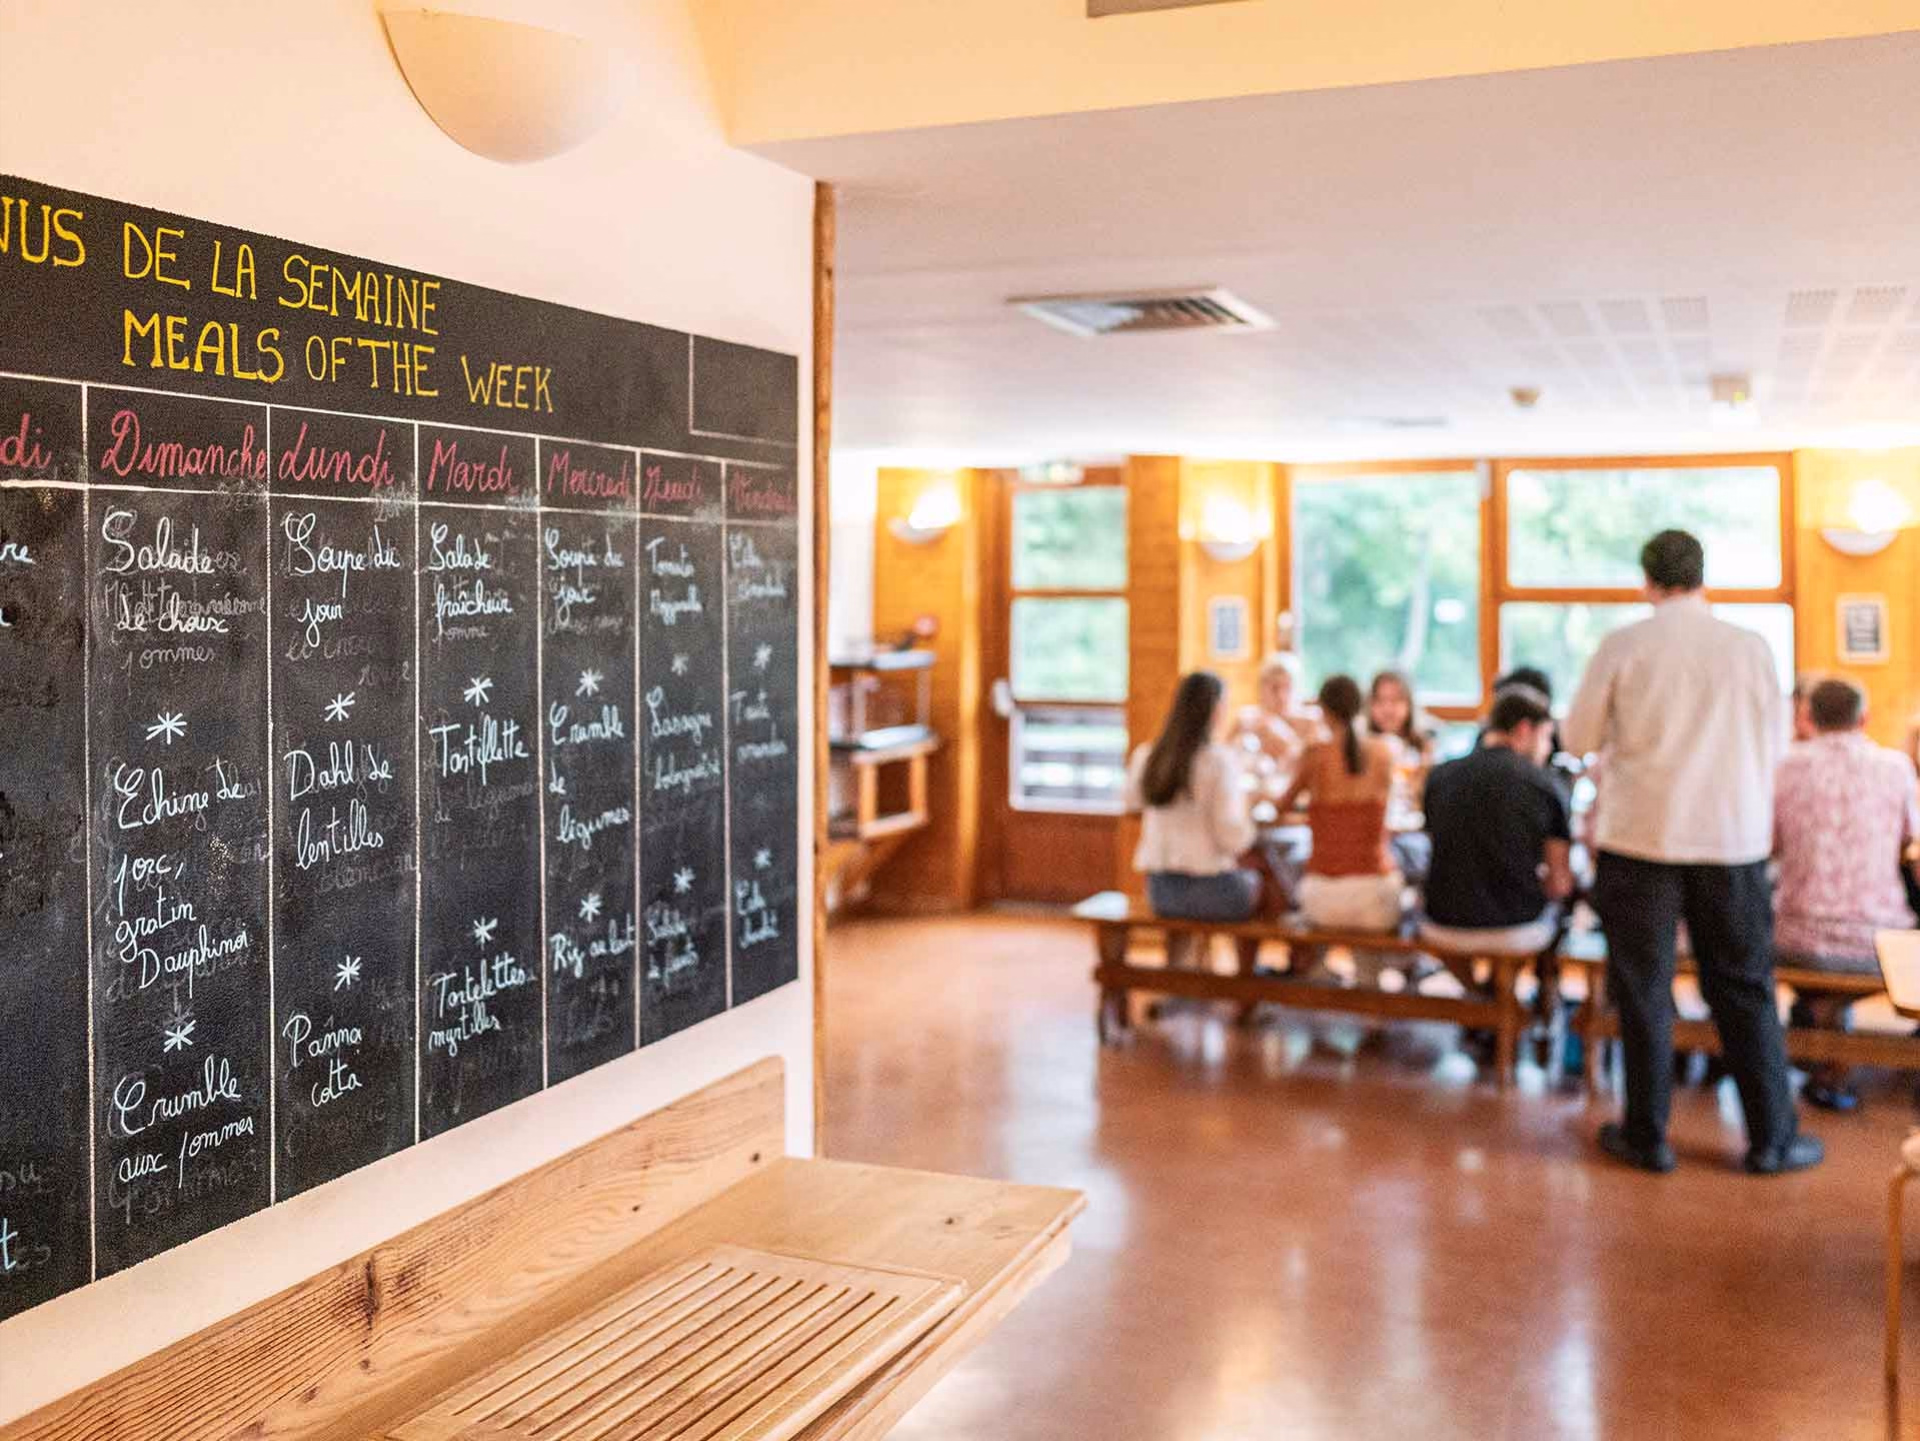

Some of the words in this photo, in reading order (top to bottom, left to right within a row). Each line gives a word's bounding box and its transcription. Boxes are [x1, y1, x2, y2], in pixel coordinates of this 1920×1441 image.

[122, 221, 190, 291] DE
[210, 239, 258, 300] LA
[278, 254, 442, 337] SEMAINE
[121, 309, 285, 384] MEALS
[304, 334, 353, 382] OF
[357, 338, 440, 397] THE
[460, 355, 555, 413] WEEK
[101, 409, 267, 479] Dimanche
[278, 421, 395, 488] Lundi
[426, 437, 514, 494] Mardi
[101, 510, 216, 574] Salade
[284, 511, 366, 599] Soupe
[373, 524, 401, 568] du
[428, 521, 491, 571] Salade
[297, 598, 344, 648] jour
[283, 739, 356, 802] Dahl
[295, 797, 385, 872] lentilles
[115, 885, 197, 963] gratin
[282, 1013, 364, 1068] Panna
[113, 1053, 242, 1135] Crumble
[311, 1058, 364, 1108] cotta
[118, 1151, 168, 1184] aux
[178, 1115, 255, 1190] pommes
